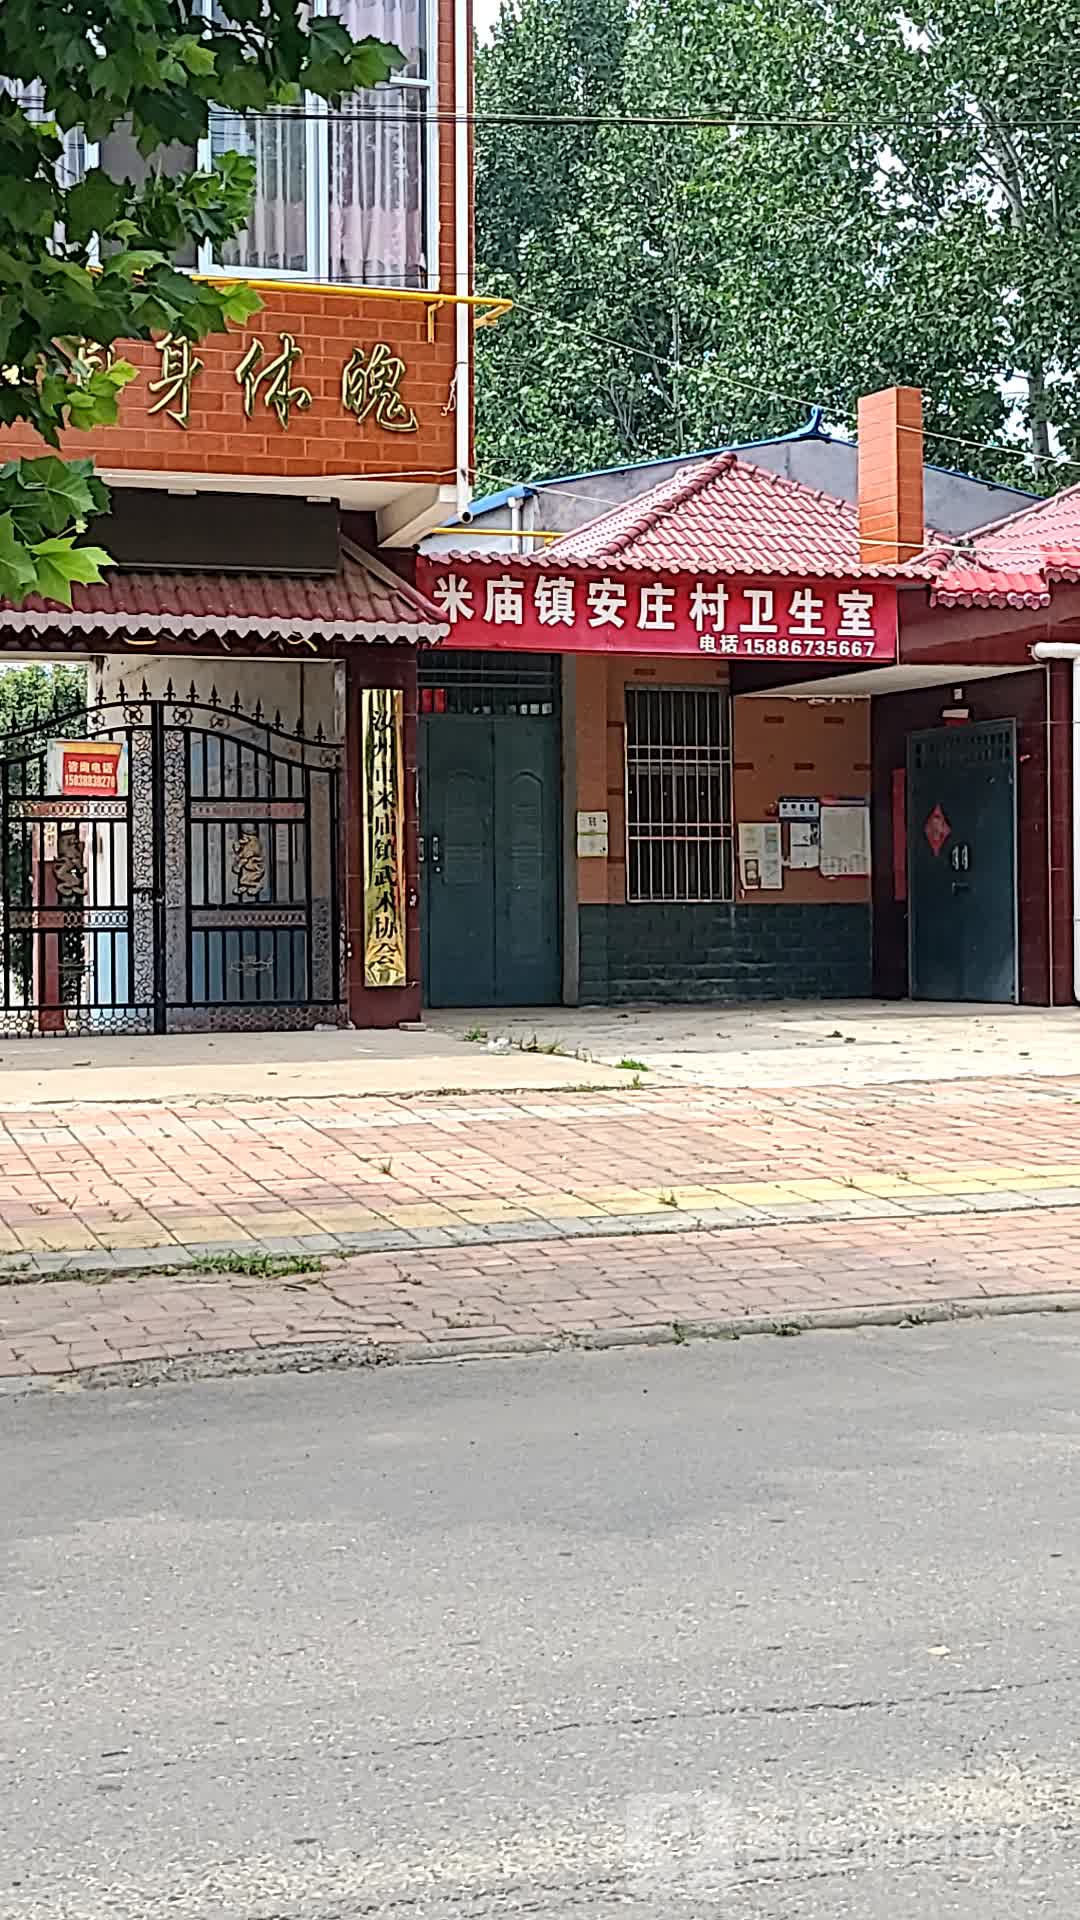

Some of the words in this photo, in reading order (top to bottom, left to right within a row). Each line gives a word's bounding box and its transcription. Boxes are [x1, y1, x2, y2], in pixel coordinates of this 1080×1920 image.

[432, 574, 875, 637] 米庙镇安庄村卫生室
[699, 634, 739, 653] 电话
[743, 638, 875, 657] 15886735667
[67, 760, 114, 774] 咨询电话
